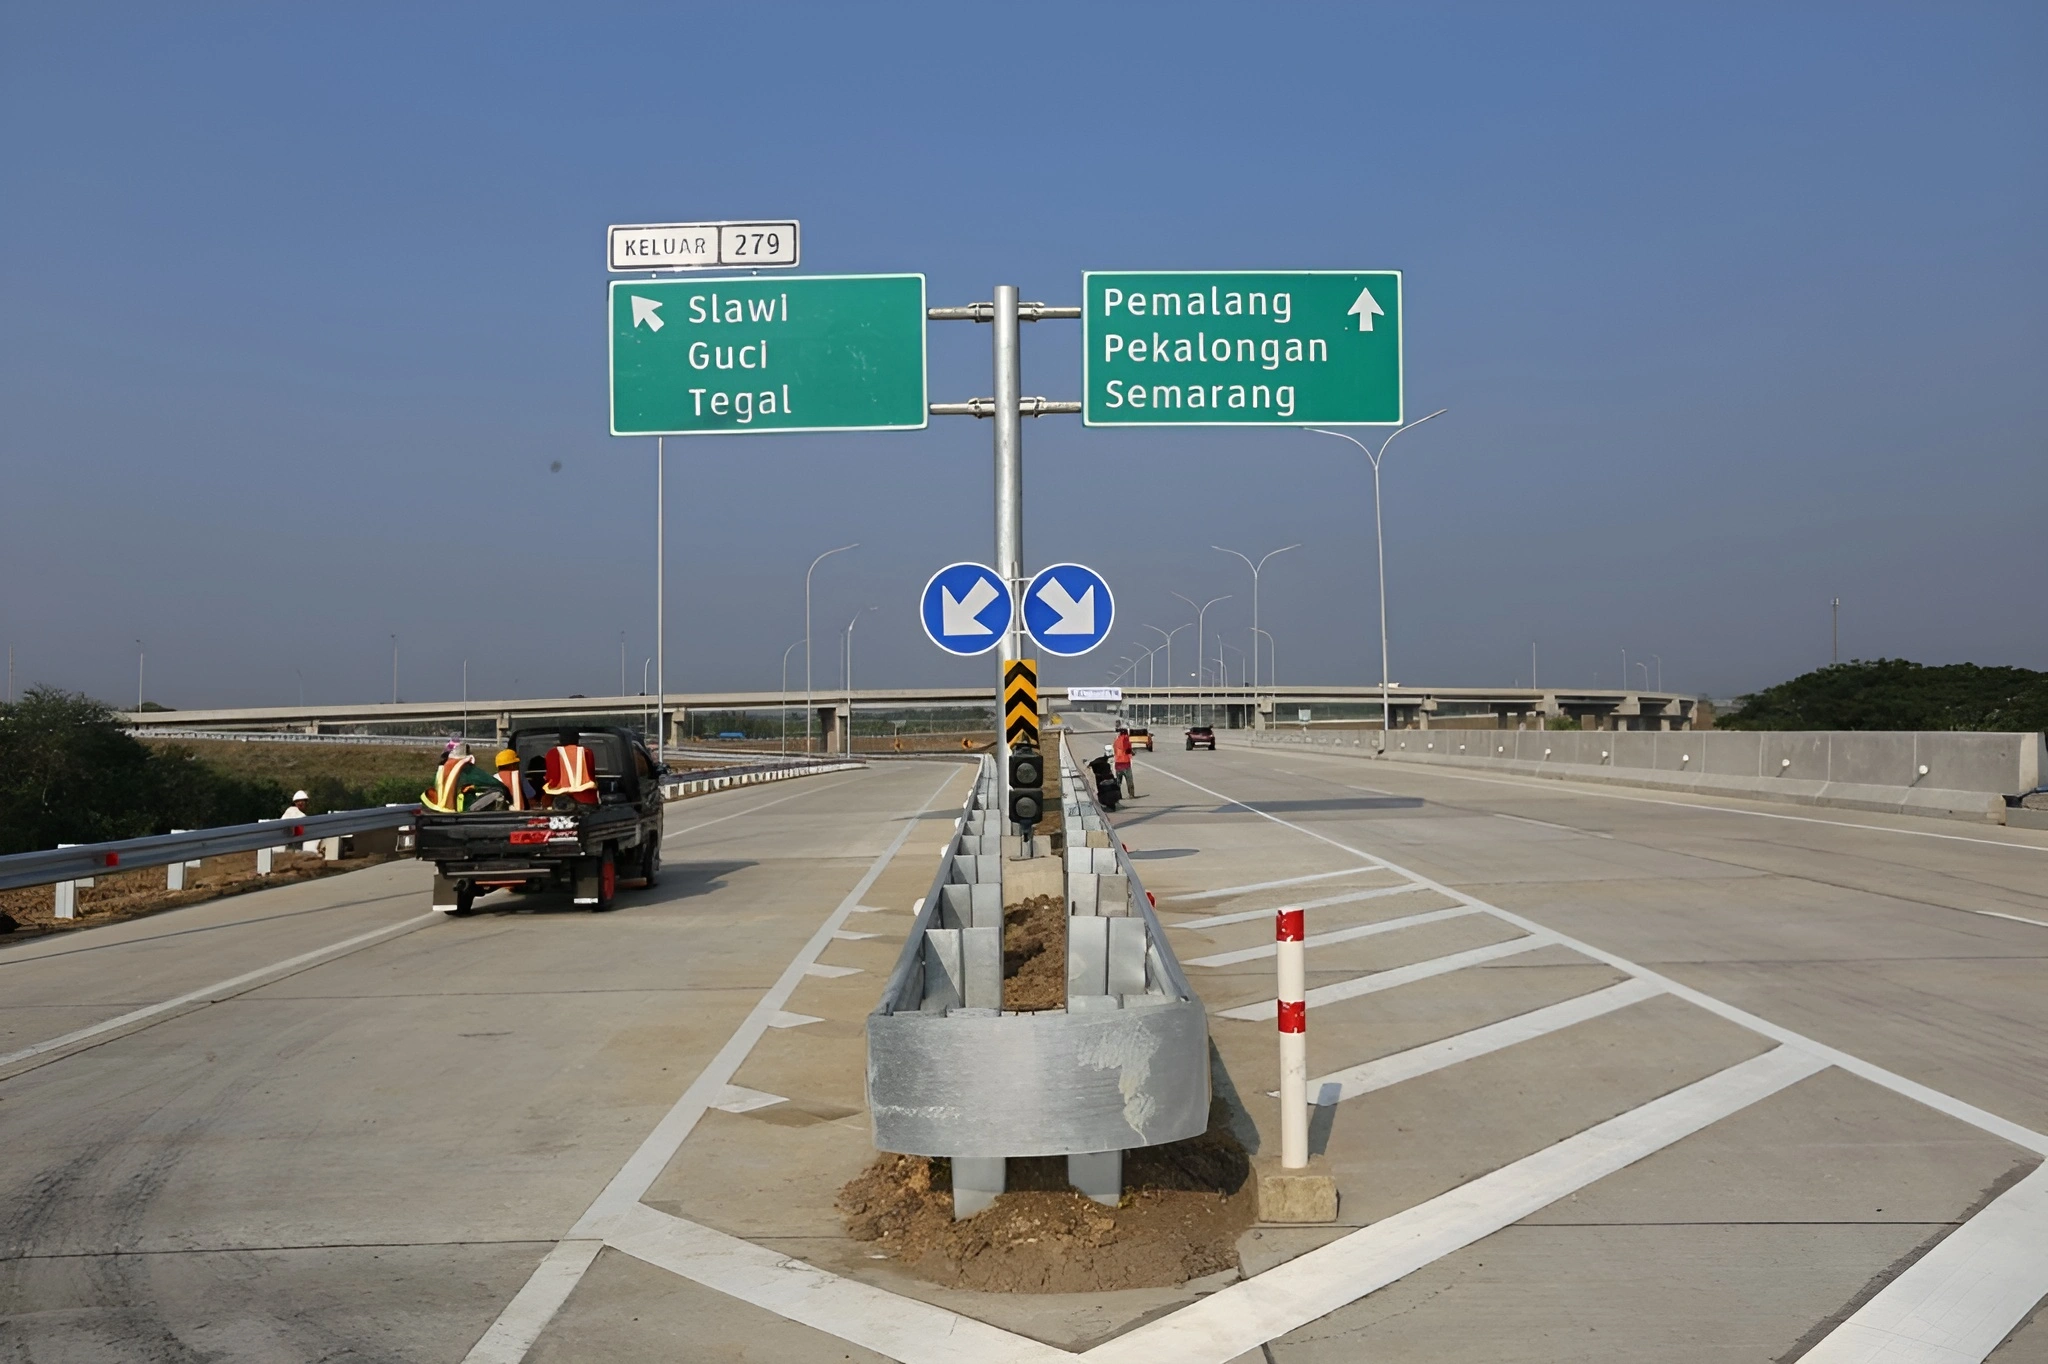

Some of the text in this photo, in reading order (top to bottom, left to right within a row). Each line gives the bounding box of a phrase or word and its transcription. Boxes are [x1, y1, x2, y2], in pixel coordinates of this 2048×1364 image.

[625, 233, 780, 256] KELUAR 279
[688, 293, 788, 324] Slawi
[1104, 286, 1291, 323] Pemalang
[688, 340, 767, 369] Guci
[1105, 332, 1327, 371] Pekalongan
[688, 384, 792, 423] Tegal
[1105, 380, 1295, 417] Semarang
